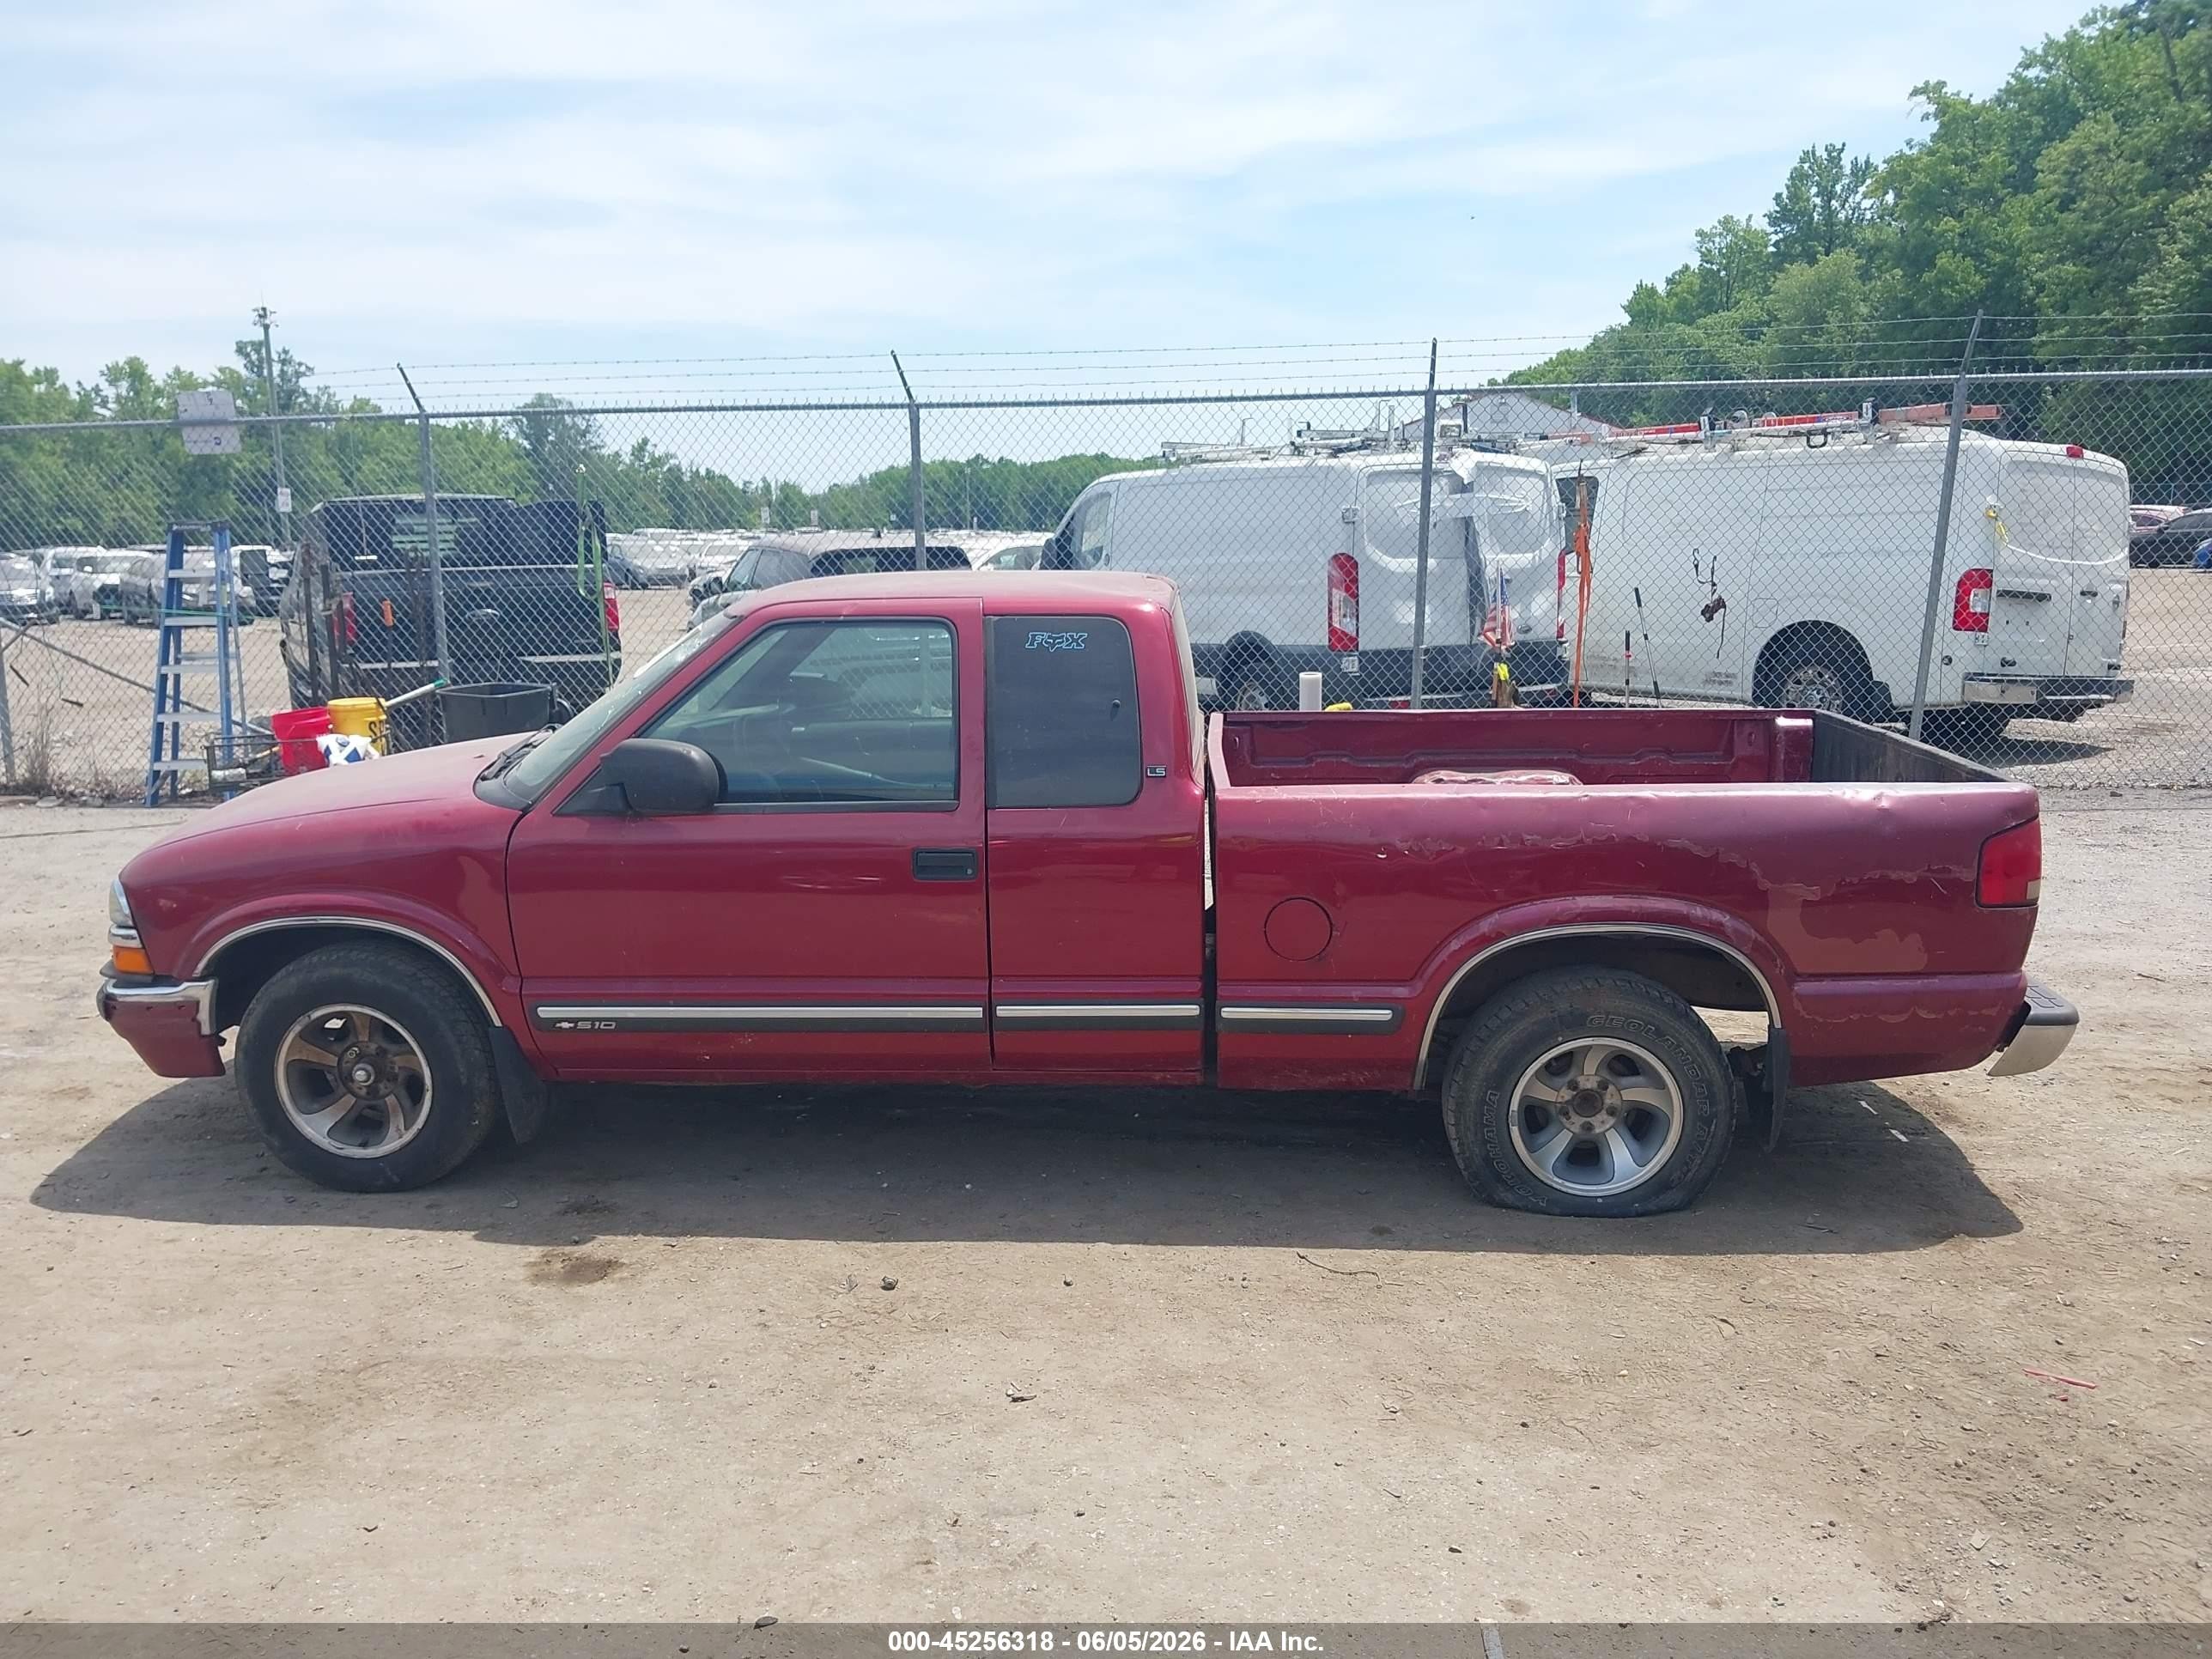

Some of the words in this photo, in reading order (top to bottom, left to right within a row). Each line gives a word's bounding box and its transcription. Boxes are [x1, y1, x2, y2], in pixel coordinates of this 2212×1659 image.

[1024, 632, 1088, 653] FOX
[1147, 768, 1166, 777] LS
[576, 1021, 617, 1030] S10
[1587, 1014, 1710, 1116] GEOLANDAR
[1484, 1090, 1548, 1206] YOKOHAMA
